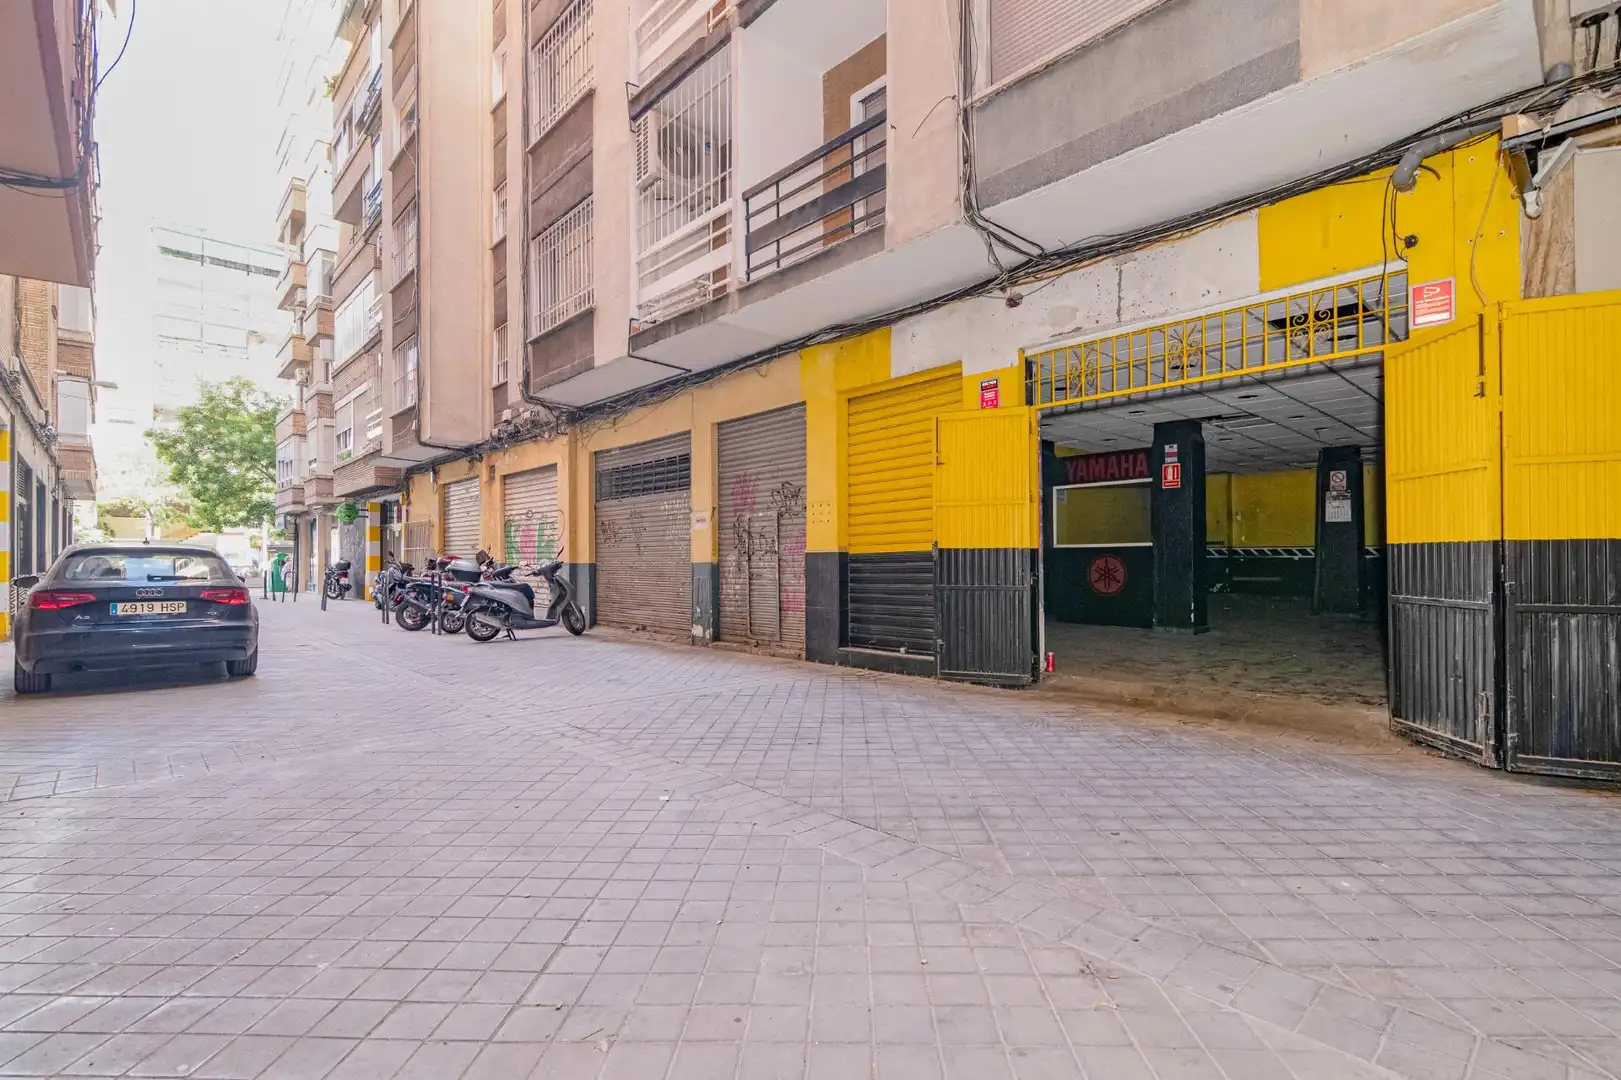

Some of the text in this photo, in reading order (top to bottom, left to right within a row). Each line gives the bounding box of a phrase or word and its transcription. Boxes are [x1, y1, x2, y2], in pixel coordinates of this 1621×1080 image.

[1065, 452, 1149, 482] YAMAHA
[121, 602, 185, 613] 4919 HSP
